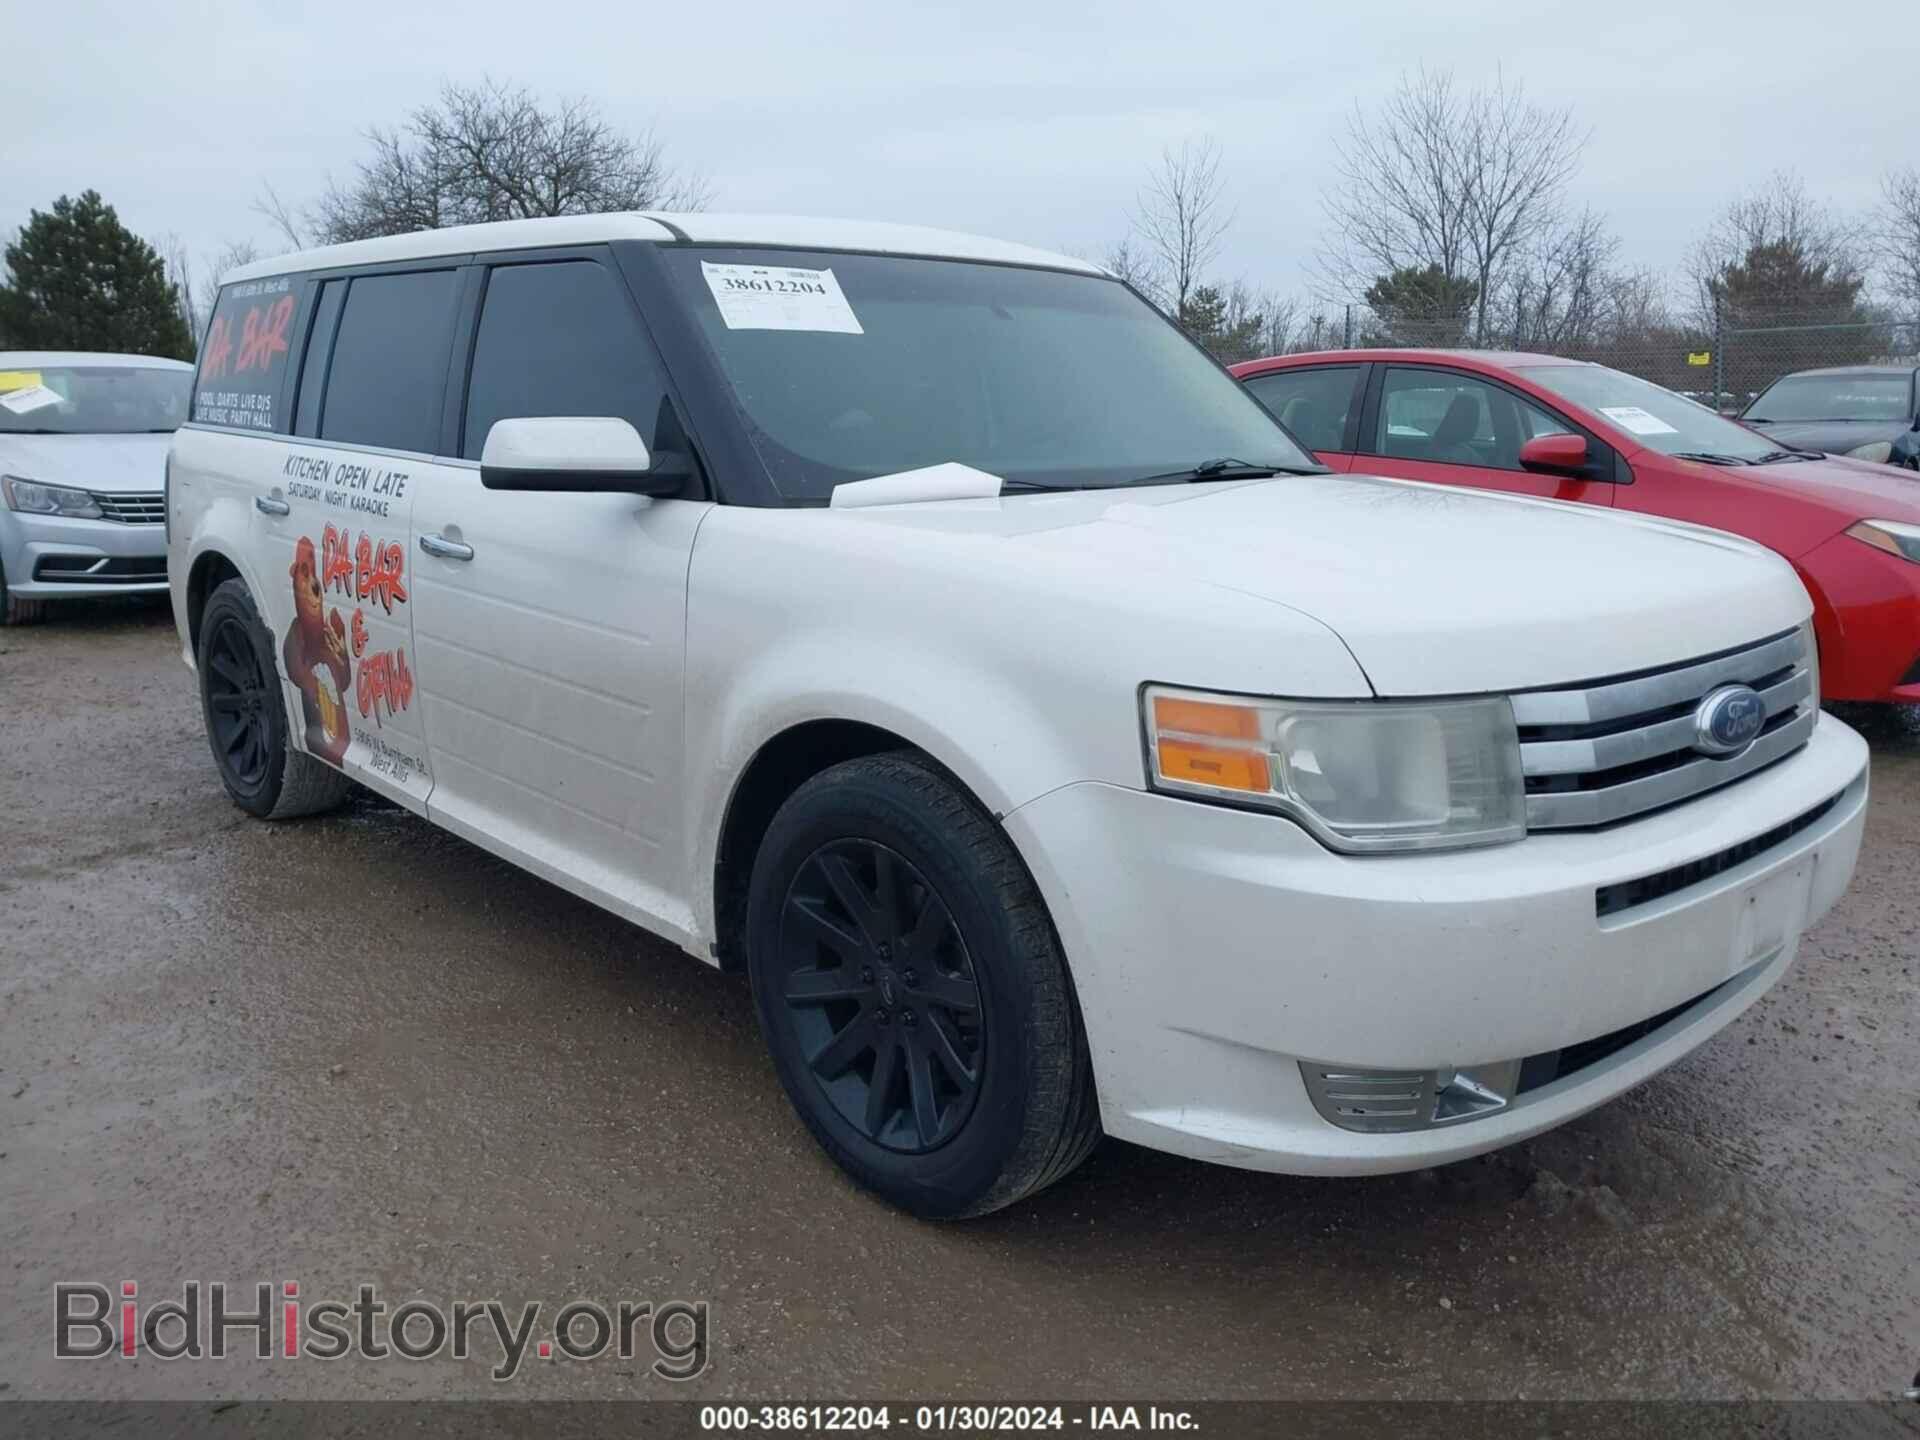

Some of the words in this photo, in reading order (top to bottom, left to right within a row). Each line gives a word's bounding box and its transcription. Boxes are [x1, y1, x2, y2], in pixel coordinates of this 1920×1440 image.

[723, 277, 827, 295] 38612204
[235, 296, 294, 374] BAR
[217, 391, 239, 407] DARTS
[241, 393, 257, 409] LIVE
[209, 408, 228, 423] MUSIC
[230, 409, 251, 425] PARTY
[252, 411, 272, 428] HALL
[283, 454, 333, 483] KITCHEN
[335, 463, 371, 491] OPEN
[373, 471, 409, 498] LATE
[288, 481, 322, 501] SATURDAY
[325, 490, 348, 508] NIGHT
[350, 495, 389, 518] KARAOKE
[322, 521, 353, 597] DA
[355, 530, 409, 616] BAR
[370, 753, 391, 774] West
